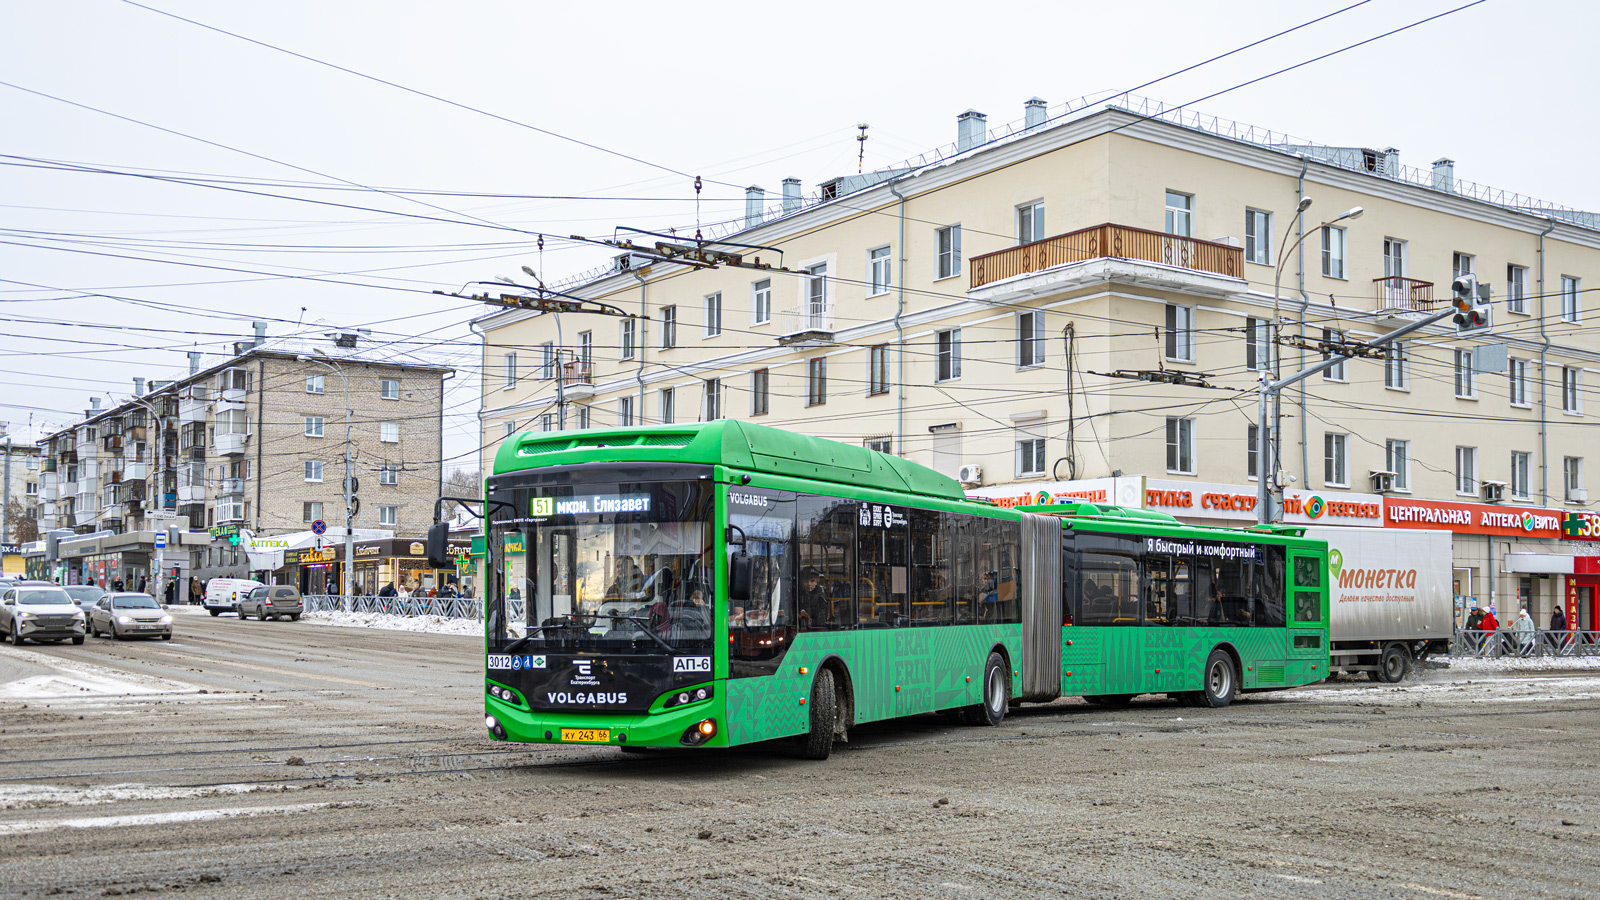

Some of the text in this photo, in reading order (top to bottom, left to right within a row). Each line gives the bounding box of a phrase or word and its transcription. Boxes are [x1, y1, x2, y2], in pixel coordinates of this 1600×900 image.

[536, 499, 549, 514] 51
[593, 496, 649, 512] Елизавет
[729, 492, 768, 507] VOLGABUS
[1327, 500, 1380, 518] взгляд
[1389, 505, 1560, 531] ЦЕНТРАЛЬНАЯ АПТЕКА ВИТА
[250, 540, 289, 548] АПТЕКА
[1147, 538, 1256, 559] Я быстрый и комфортный
[1339, 593, 1360, 603] Делаем
[1386, 592, 1415, 604] доступным
[895, 629, 931, 657] EKAT
[1144, 628, 1186, 648] EKAT
[489, 655, 510, 668] 3012
[675, 658, 709, 670] АП-6
[1144, 650, 1186, 670] ERIN
[895, 658, 931, 687] ERIN
[1144, 671, 1186, 692] BURG
[547, 692, 628, 704] VOLGABUS
[896, 686, 931, 716] BURG
[578, 731, 595, 740] 243
